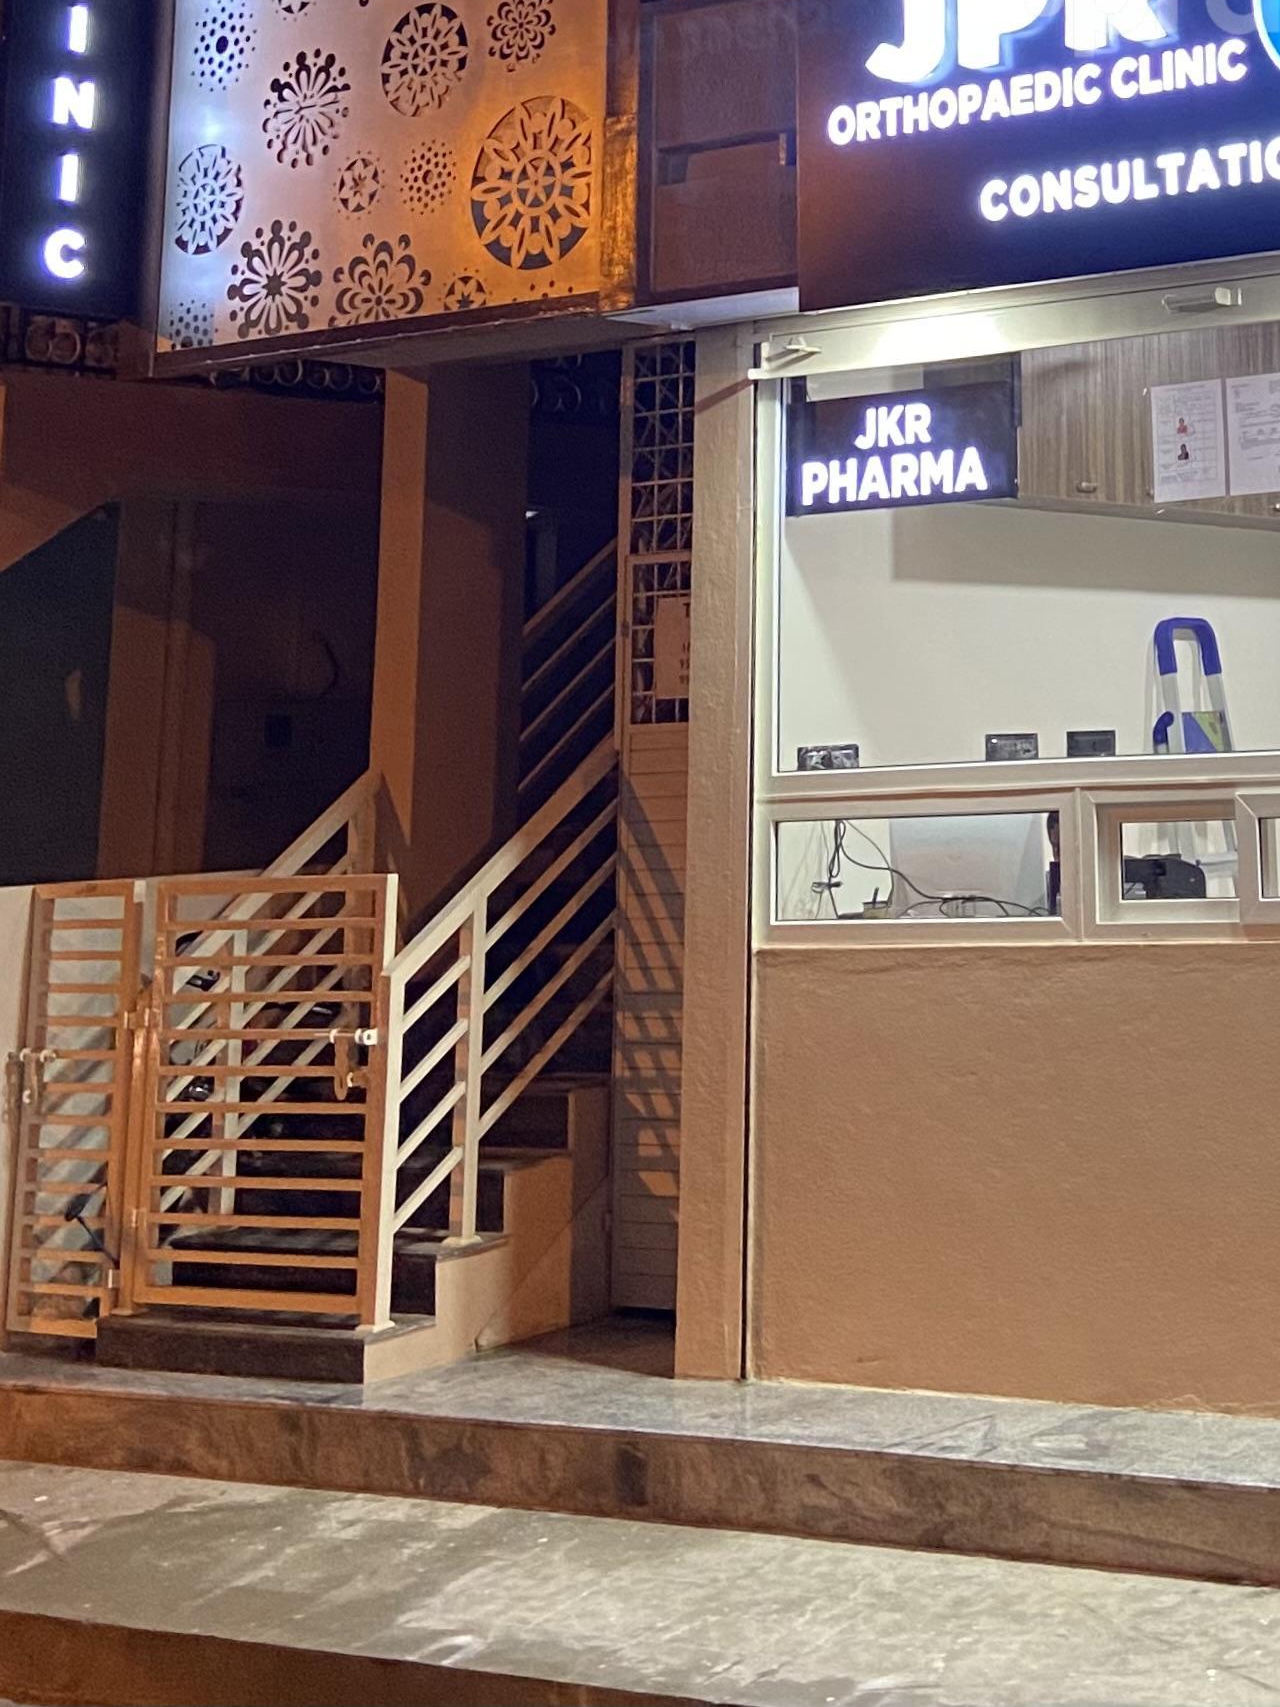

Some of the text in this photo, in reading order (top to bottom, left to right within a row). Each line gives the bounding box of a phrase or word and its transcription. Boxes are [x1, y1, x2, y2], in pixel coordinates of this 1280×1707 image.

[826, 38, 1249, 146] ORTHOPAEDIC CLINIC
[853, 402, 933, 450] JKR
[801, 446, 989, 507] PHARMA
